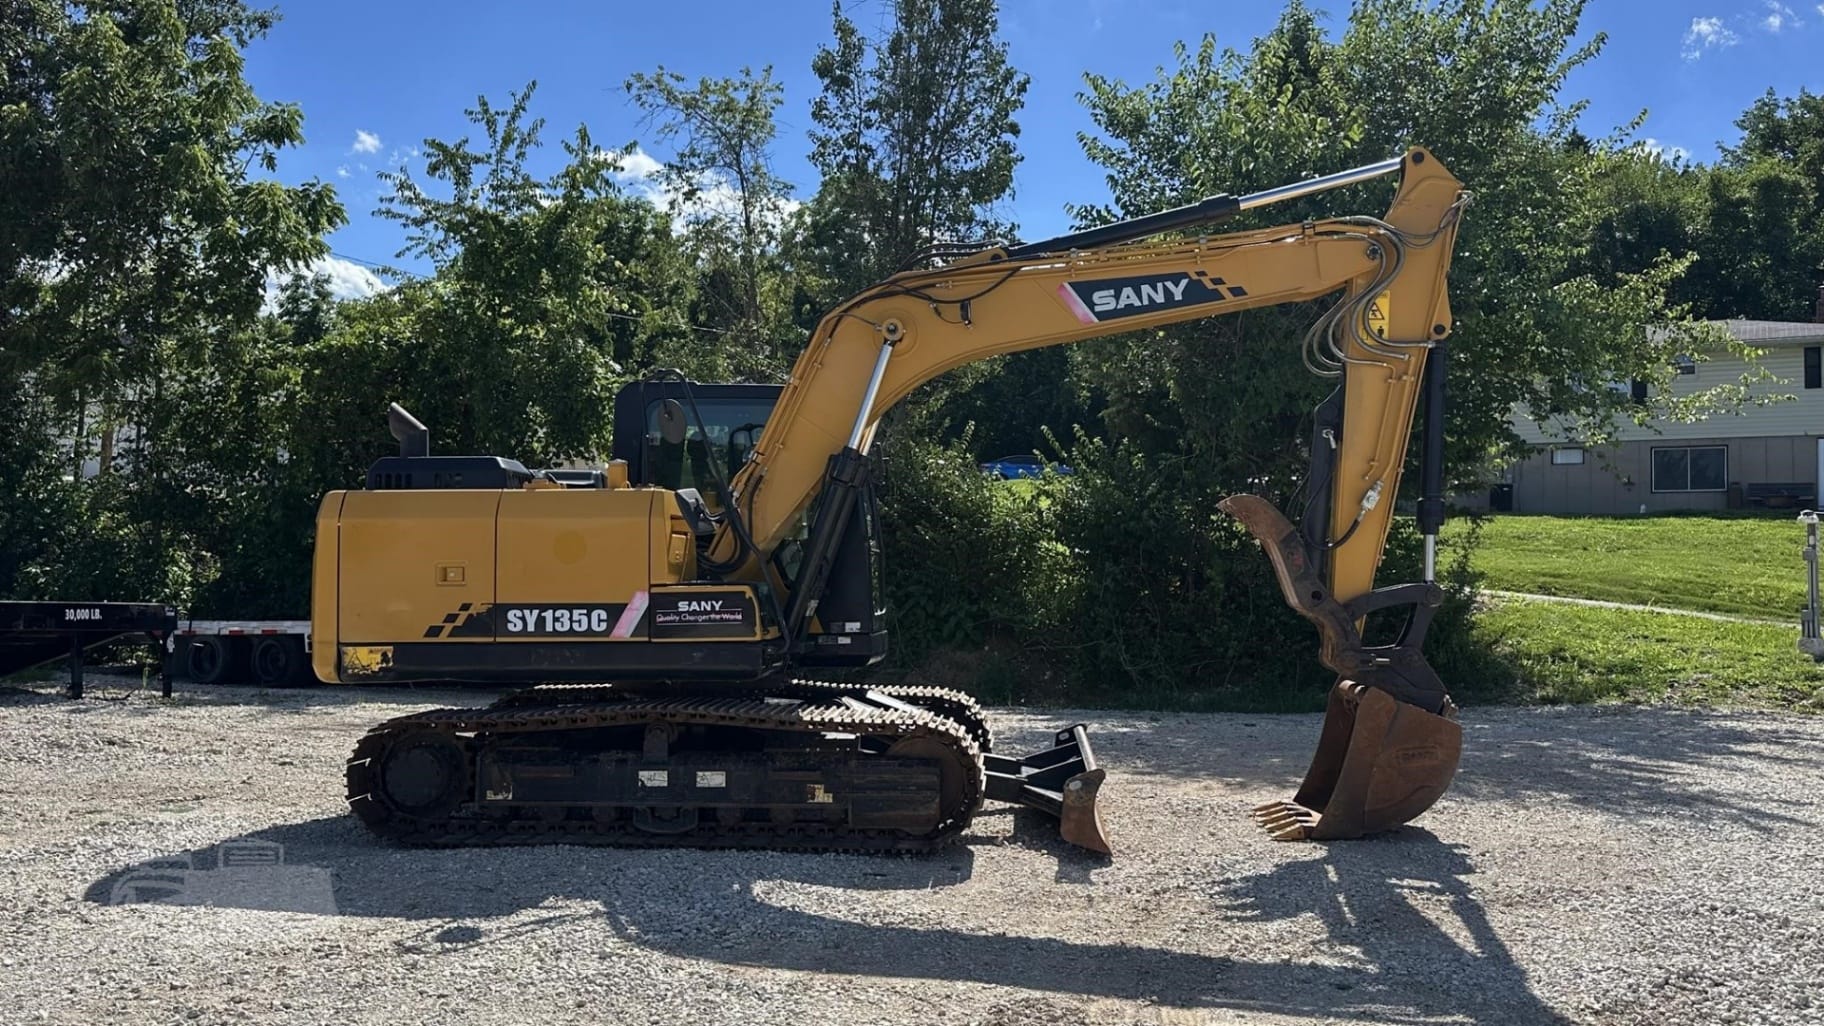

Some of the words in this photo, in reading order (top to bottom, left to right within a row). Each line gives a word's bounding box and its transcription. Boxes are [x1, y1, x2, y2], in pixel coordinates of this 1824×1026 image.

[1092, 278, 1190, 312] SANY
[678, 600, 723, 612] SANY
[65, 608, 89, 621] 30,000
[91, 608, 102, 619] LB.
[506, 609, 608, 632] SY135C
[656, 613, 680, 623] Quality
[722, 611, 743, 620] World
